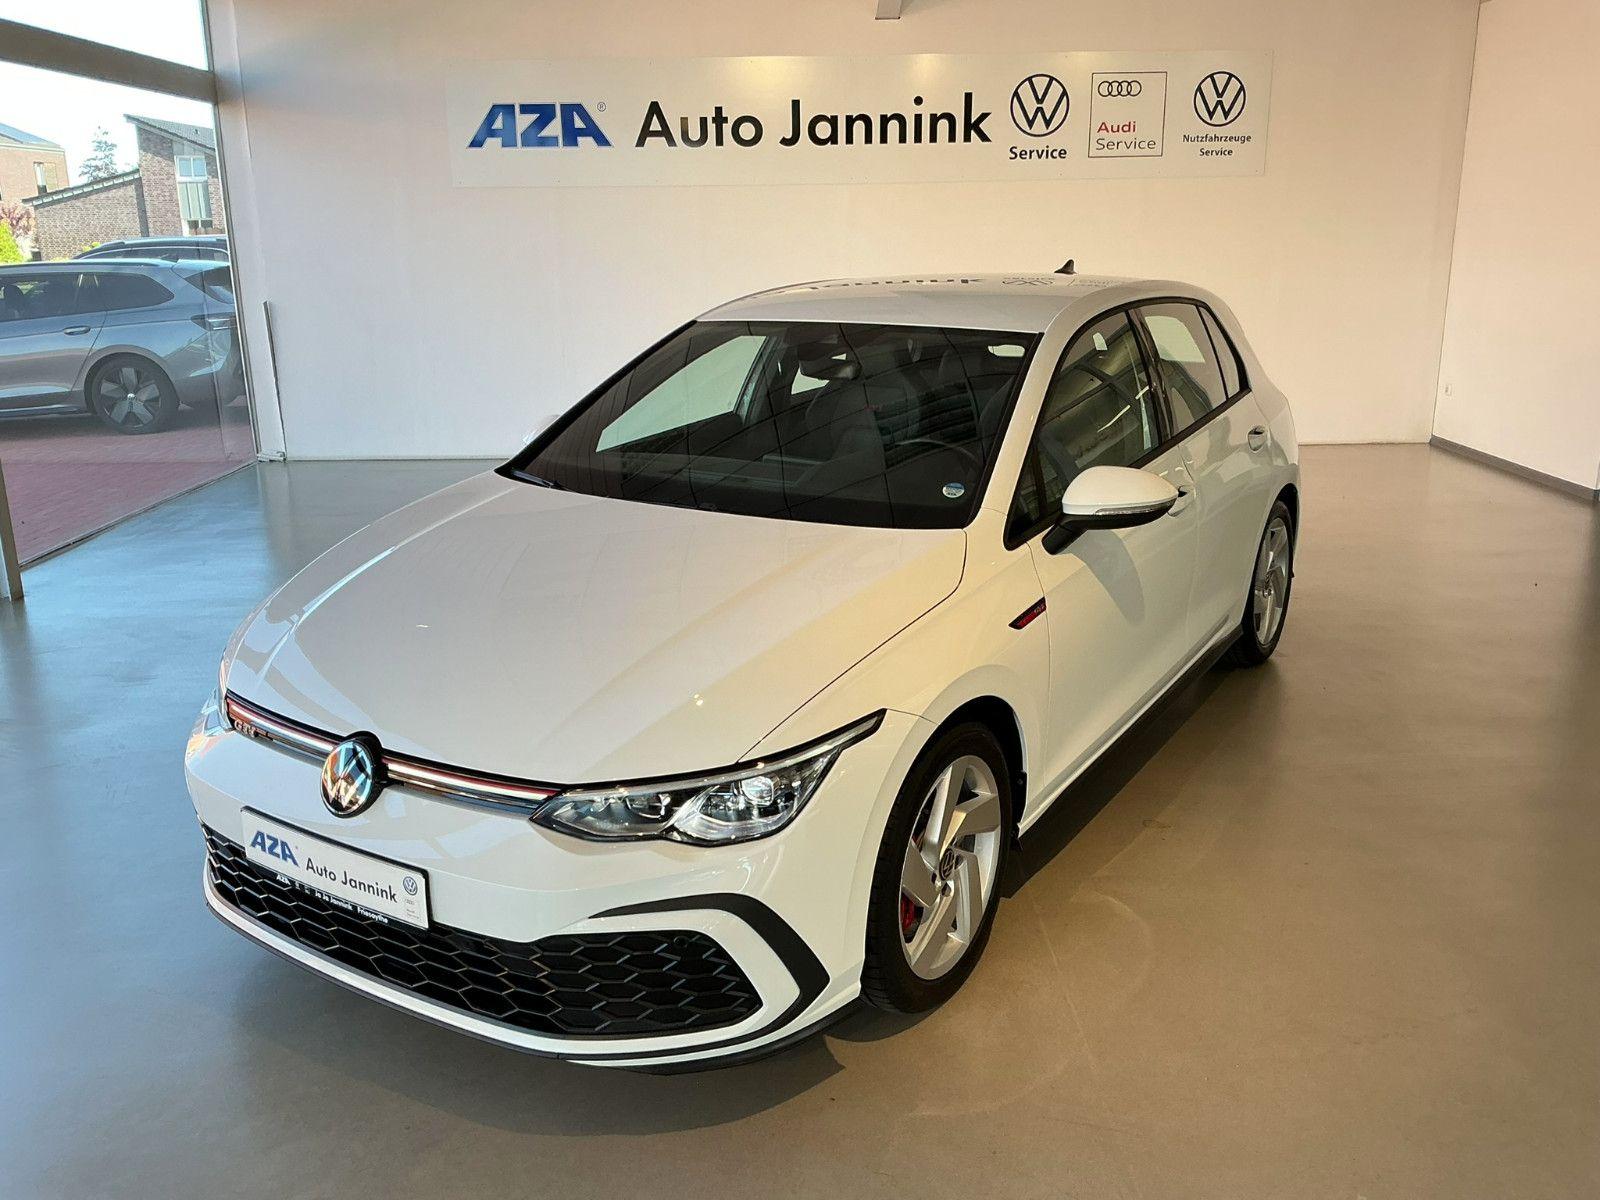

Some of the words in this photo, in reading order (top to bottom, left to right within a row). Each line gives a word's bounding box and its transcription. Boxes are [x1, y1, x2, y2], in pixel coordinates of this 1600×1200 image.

[467, 102, 613, 149] AZA
[635, 100, 764, 148] Auto
[778, 92, 992, 147] Jannink
[1096, 121, 1137, 134] Audi
[1095, 138, 1157, 151] Service
[1182, 133, 1252, 144] Nutzfahrzeuge
[1009, 145, 1068, 160] Service
[1199, 147, 1234, 157] Service
[251, 830, 299, 867] AZA
[305, 857, 337, 883] Auto
[341, 870, 398, 904] Jannink
